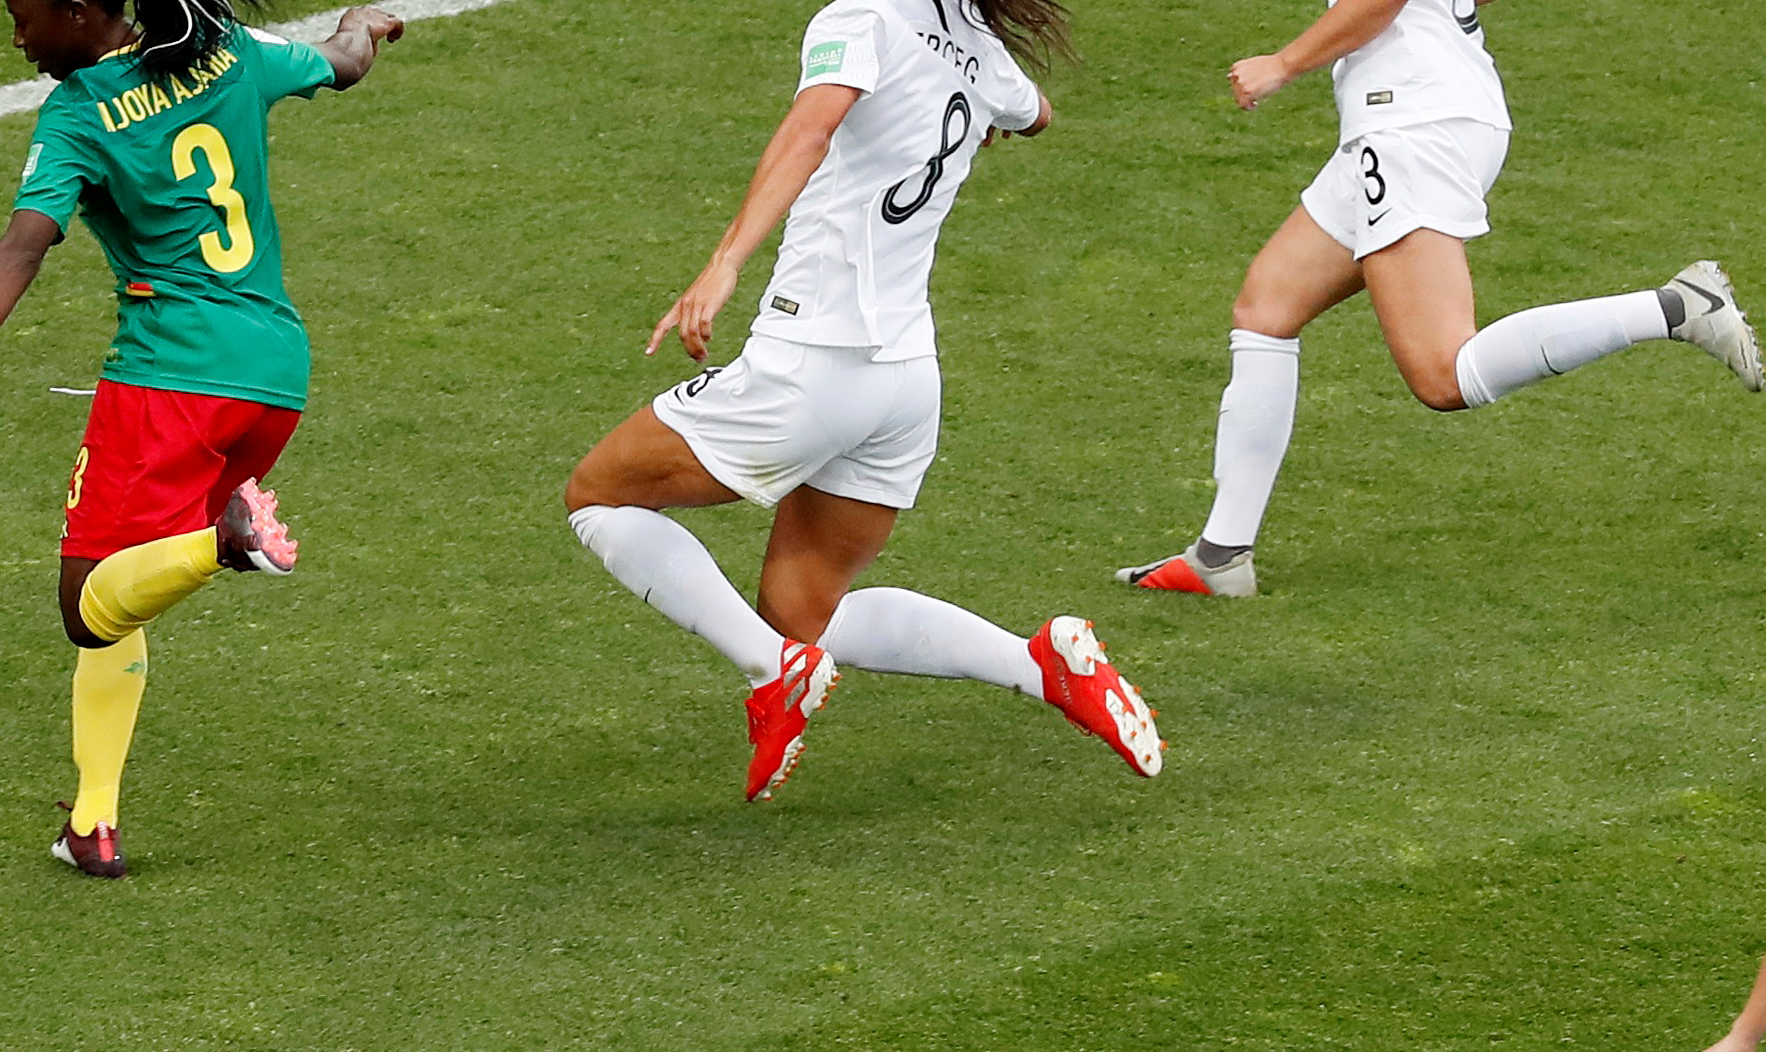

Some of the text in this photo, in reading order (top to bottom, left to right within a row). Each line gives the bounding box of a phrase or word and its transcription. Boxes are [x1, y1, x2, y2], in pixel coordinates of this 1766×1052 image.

[171, 123, 255, 273] 3
[881, 91, 972, 225] 8
[1360, 146, 1386, 206] 3
[67, 446, 90, 509] 3
